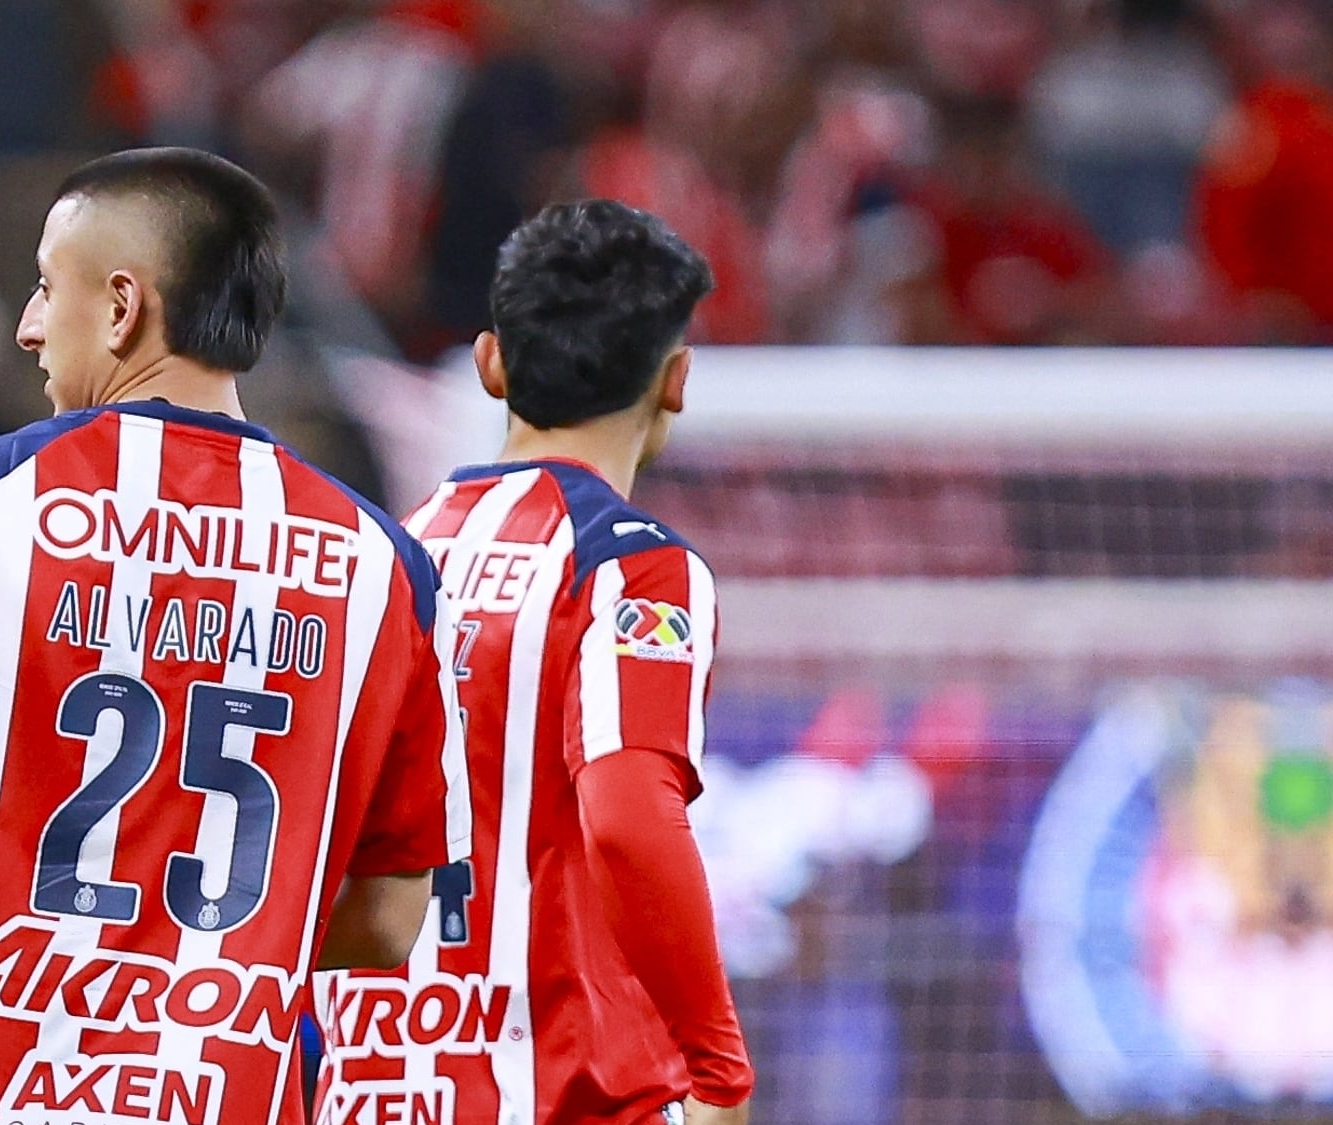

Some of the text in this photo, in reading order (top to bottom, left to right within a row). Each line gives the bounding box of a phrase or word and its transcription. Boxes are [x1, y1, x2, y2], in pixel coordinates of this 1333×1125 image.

[39, 498, 346, 587] OMNILIFE
[47, 582, 325, 678] ALVARADO
[30, 671, 293, 931] 25
[330, 984, 511, 1047] KRON
